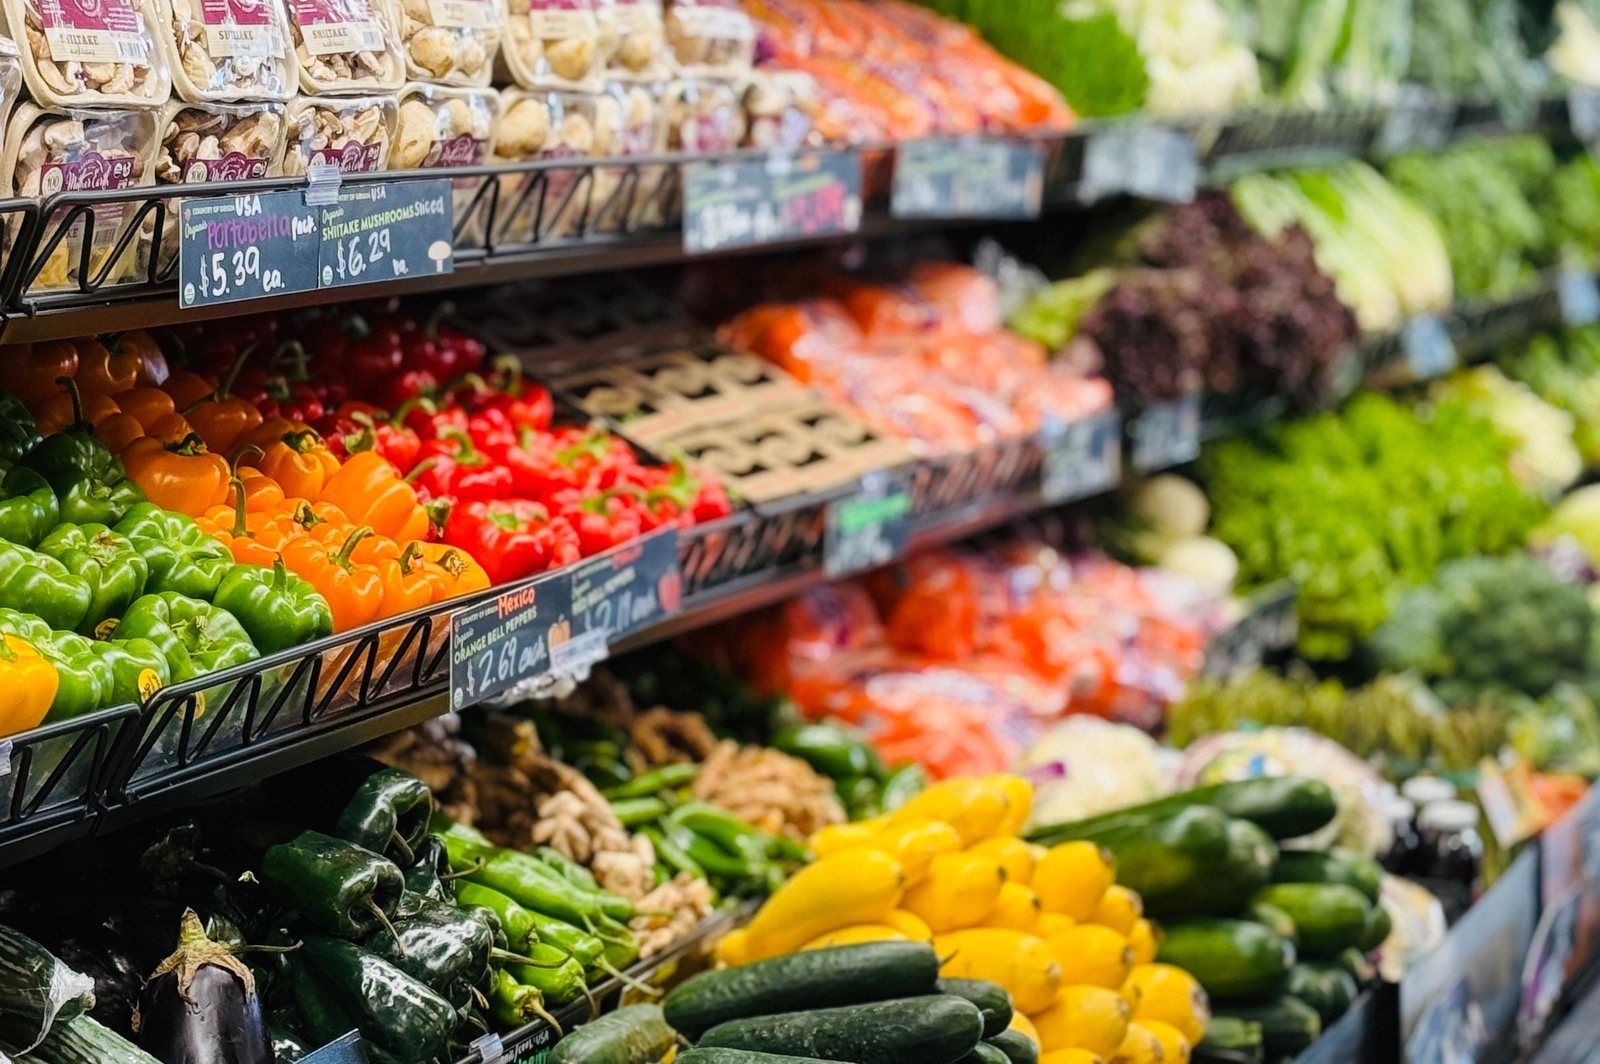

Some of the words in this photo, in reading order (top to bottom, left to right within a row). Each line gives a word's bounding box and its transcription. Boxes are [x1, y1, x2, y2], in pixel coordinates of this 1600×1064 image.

[235, 195, 262, 217] USA
[370, 186, 387, 203] USA
[322, 219, 360, 242] SHIITAKE
[360, 205, 415, 232] MUSHROOMS
[262, 269, 286, 293] ea.
[497, 587, 536, 619] Mexico
[454, 634, 487, 665] ORANGE
[487, 625, 505, 646] BELL
[505, 606, 538, 634] PEPPERS
